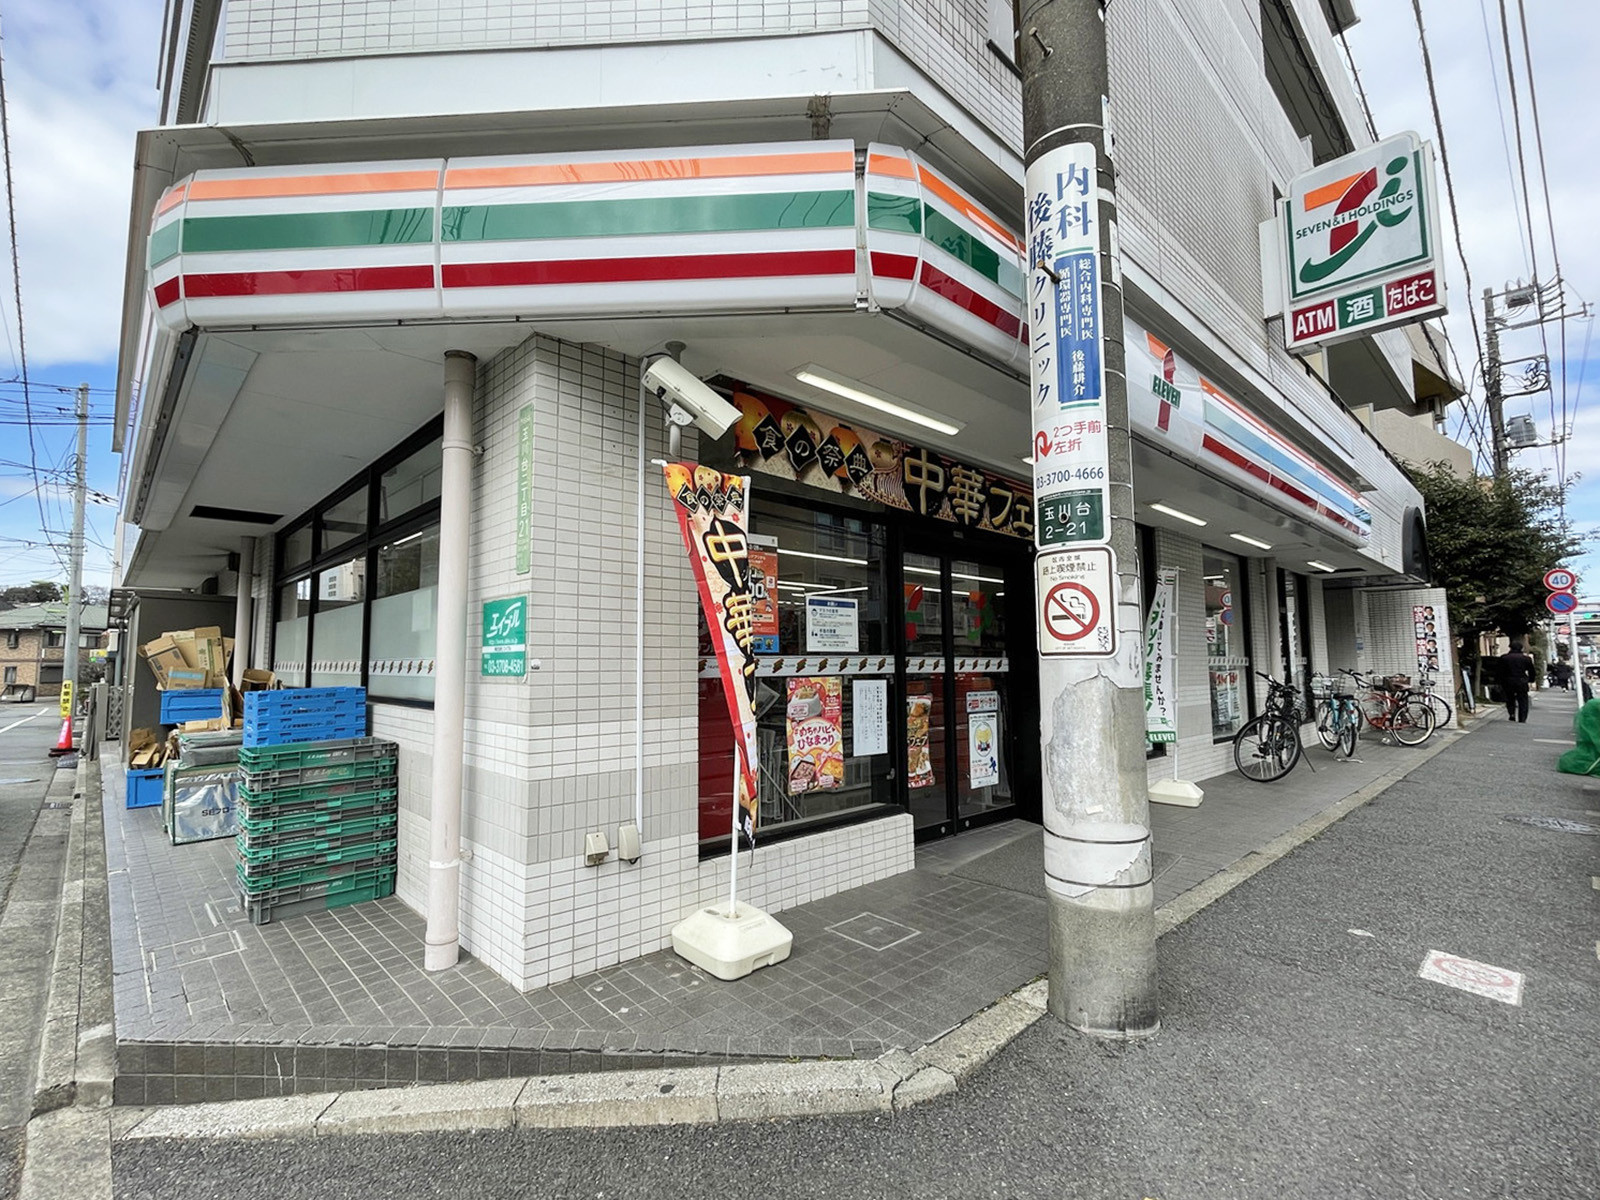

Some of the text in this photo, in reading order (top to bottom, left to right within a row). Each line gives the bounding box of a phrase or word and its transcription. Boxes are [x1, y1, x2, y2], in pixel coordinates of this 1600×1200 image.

[1055, 162, 1093, 240] 内科
[1348, 189, 1413, 221] HOLDINGS
[1028, 191, 1054, 407] 後藤クリニック
[1058, 267, 1072, 339] 循環器専門医
[1079, 258, 1094, 340] 総合内科専門医
[1295, 278, 1434, 336] ATM 酒 たばこ
[1053, 420, 1101, 438] 2つ手前
[760, 425, 869, 477] 食の祭典
[1054, 437, 1082, 455] 左折
[1036, 467, 1104, 489] 03-3700-4666
[683, 491, 742, 506] 食の祭典
[904, 449, 1033, 532] 中華フェ
[1045, 502, 1091, 521] 玉川台
[1045, 521, 1086, 539] 2-21
[1042, 562, 1097, 576] 路上喫煙禁止
[1552, 575, 1568, 585] 40
[797, 734, 835, 750] ひなまつり
